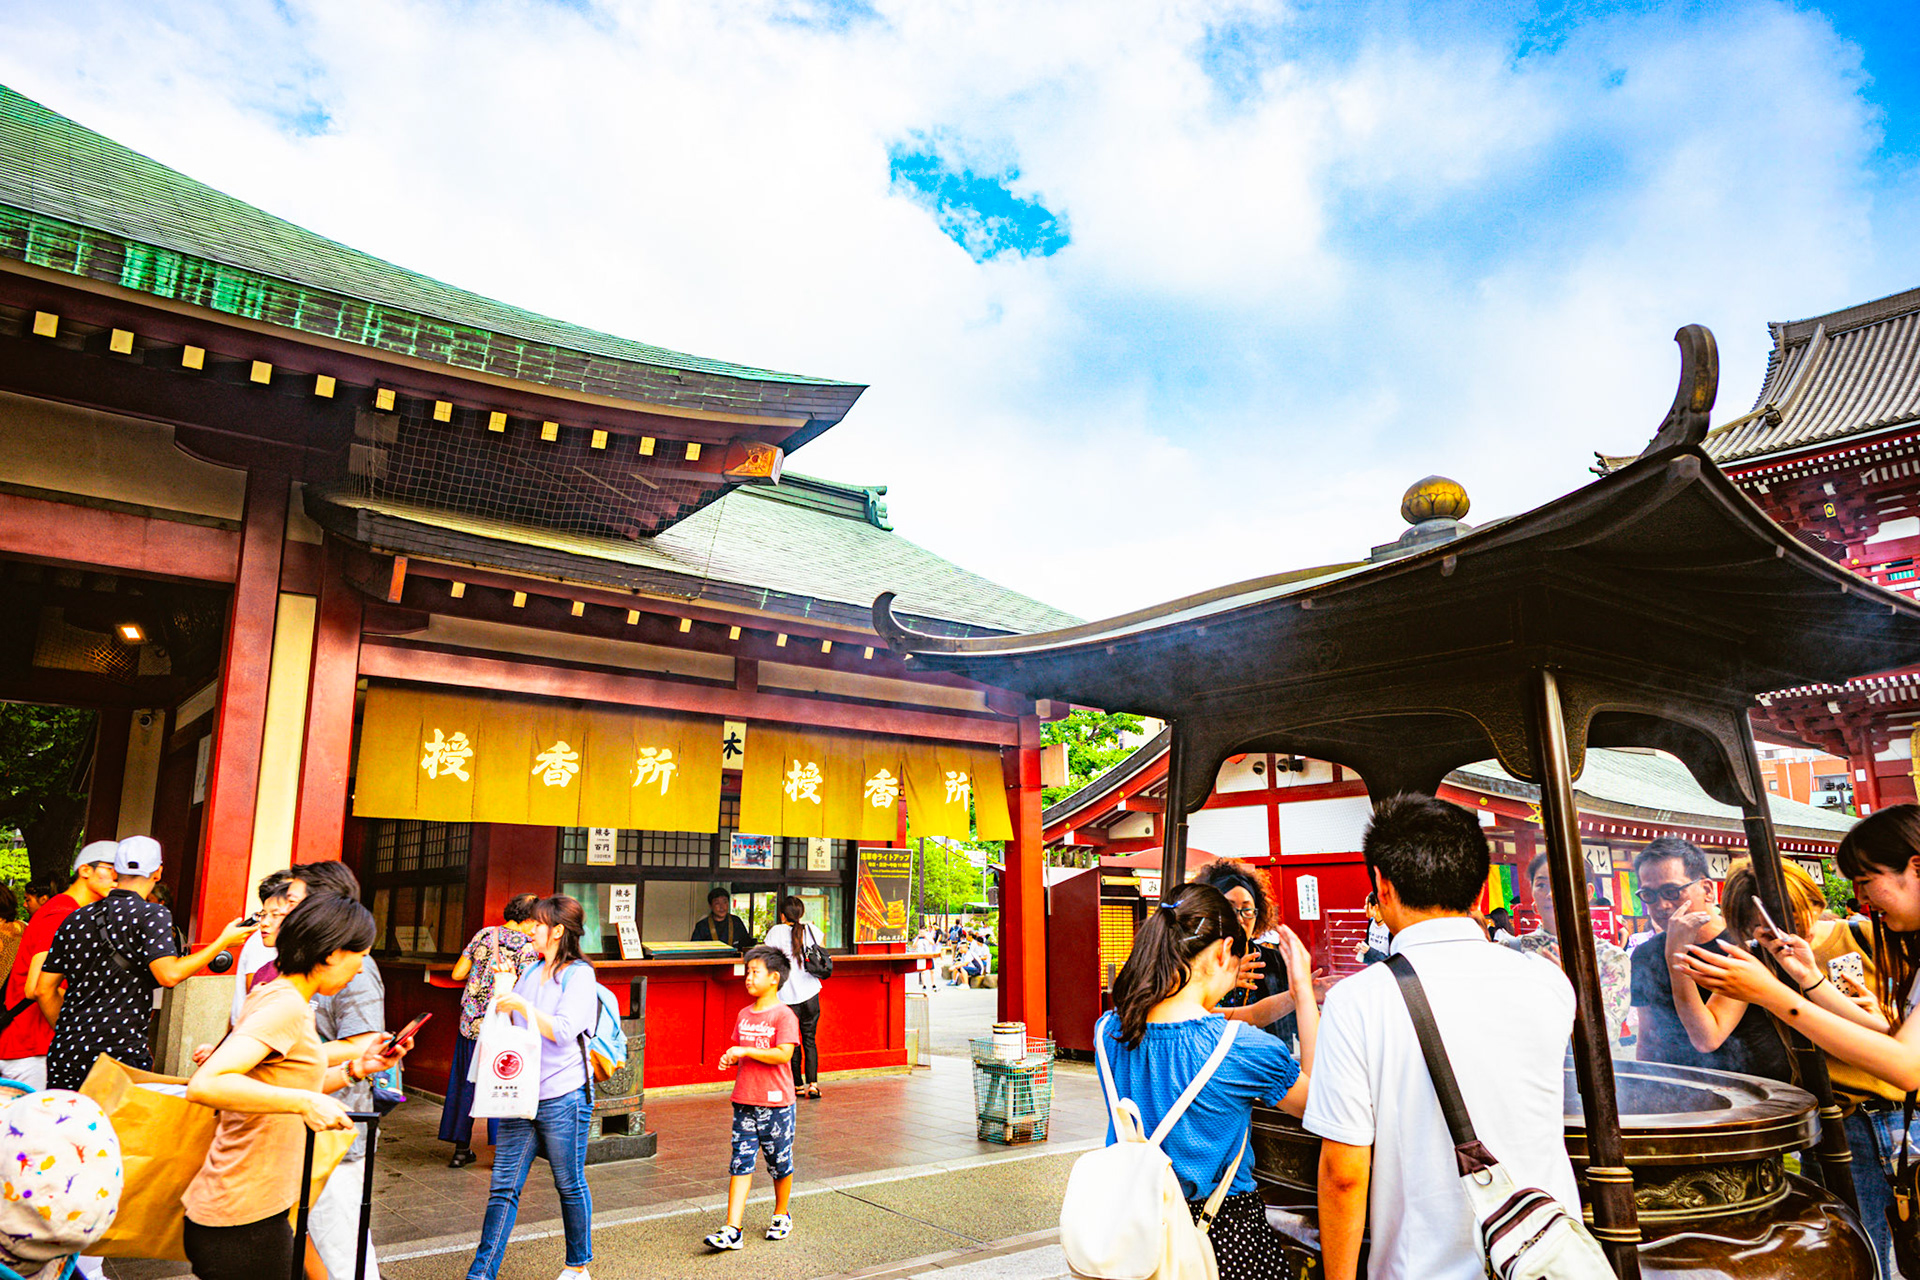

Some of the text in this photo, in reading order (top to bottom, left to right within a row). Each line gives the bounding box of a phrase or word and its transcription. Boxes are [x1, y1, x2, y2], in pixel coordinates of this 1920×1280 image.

[723, 731, 743, 760] 木
[421, 728, 677, 796] 授香所
[785, 759, 971, 812] 授香所
[1586, 848, 1606, 868] くじ
[1711, 857, 1728, 873] くじ
